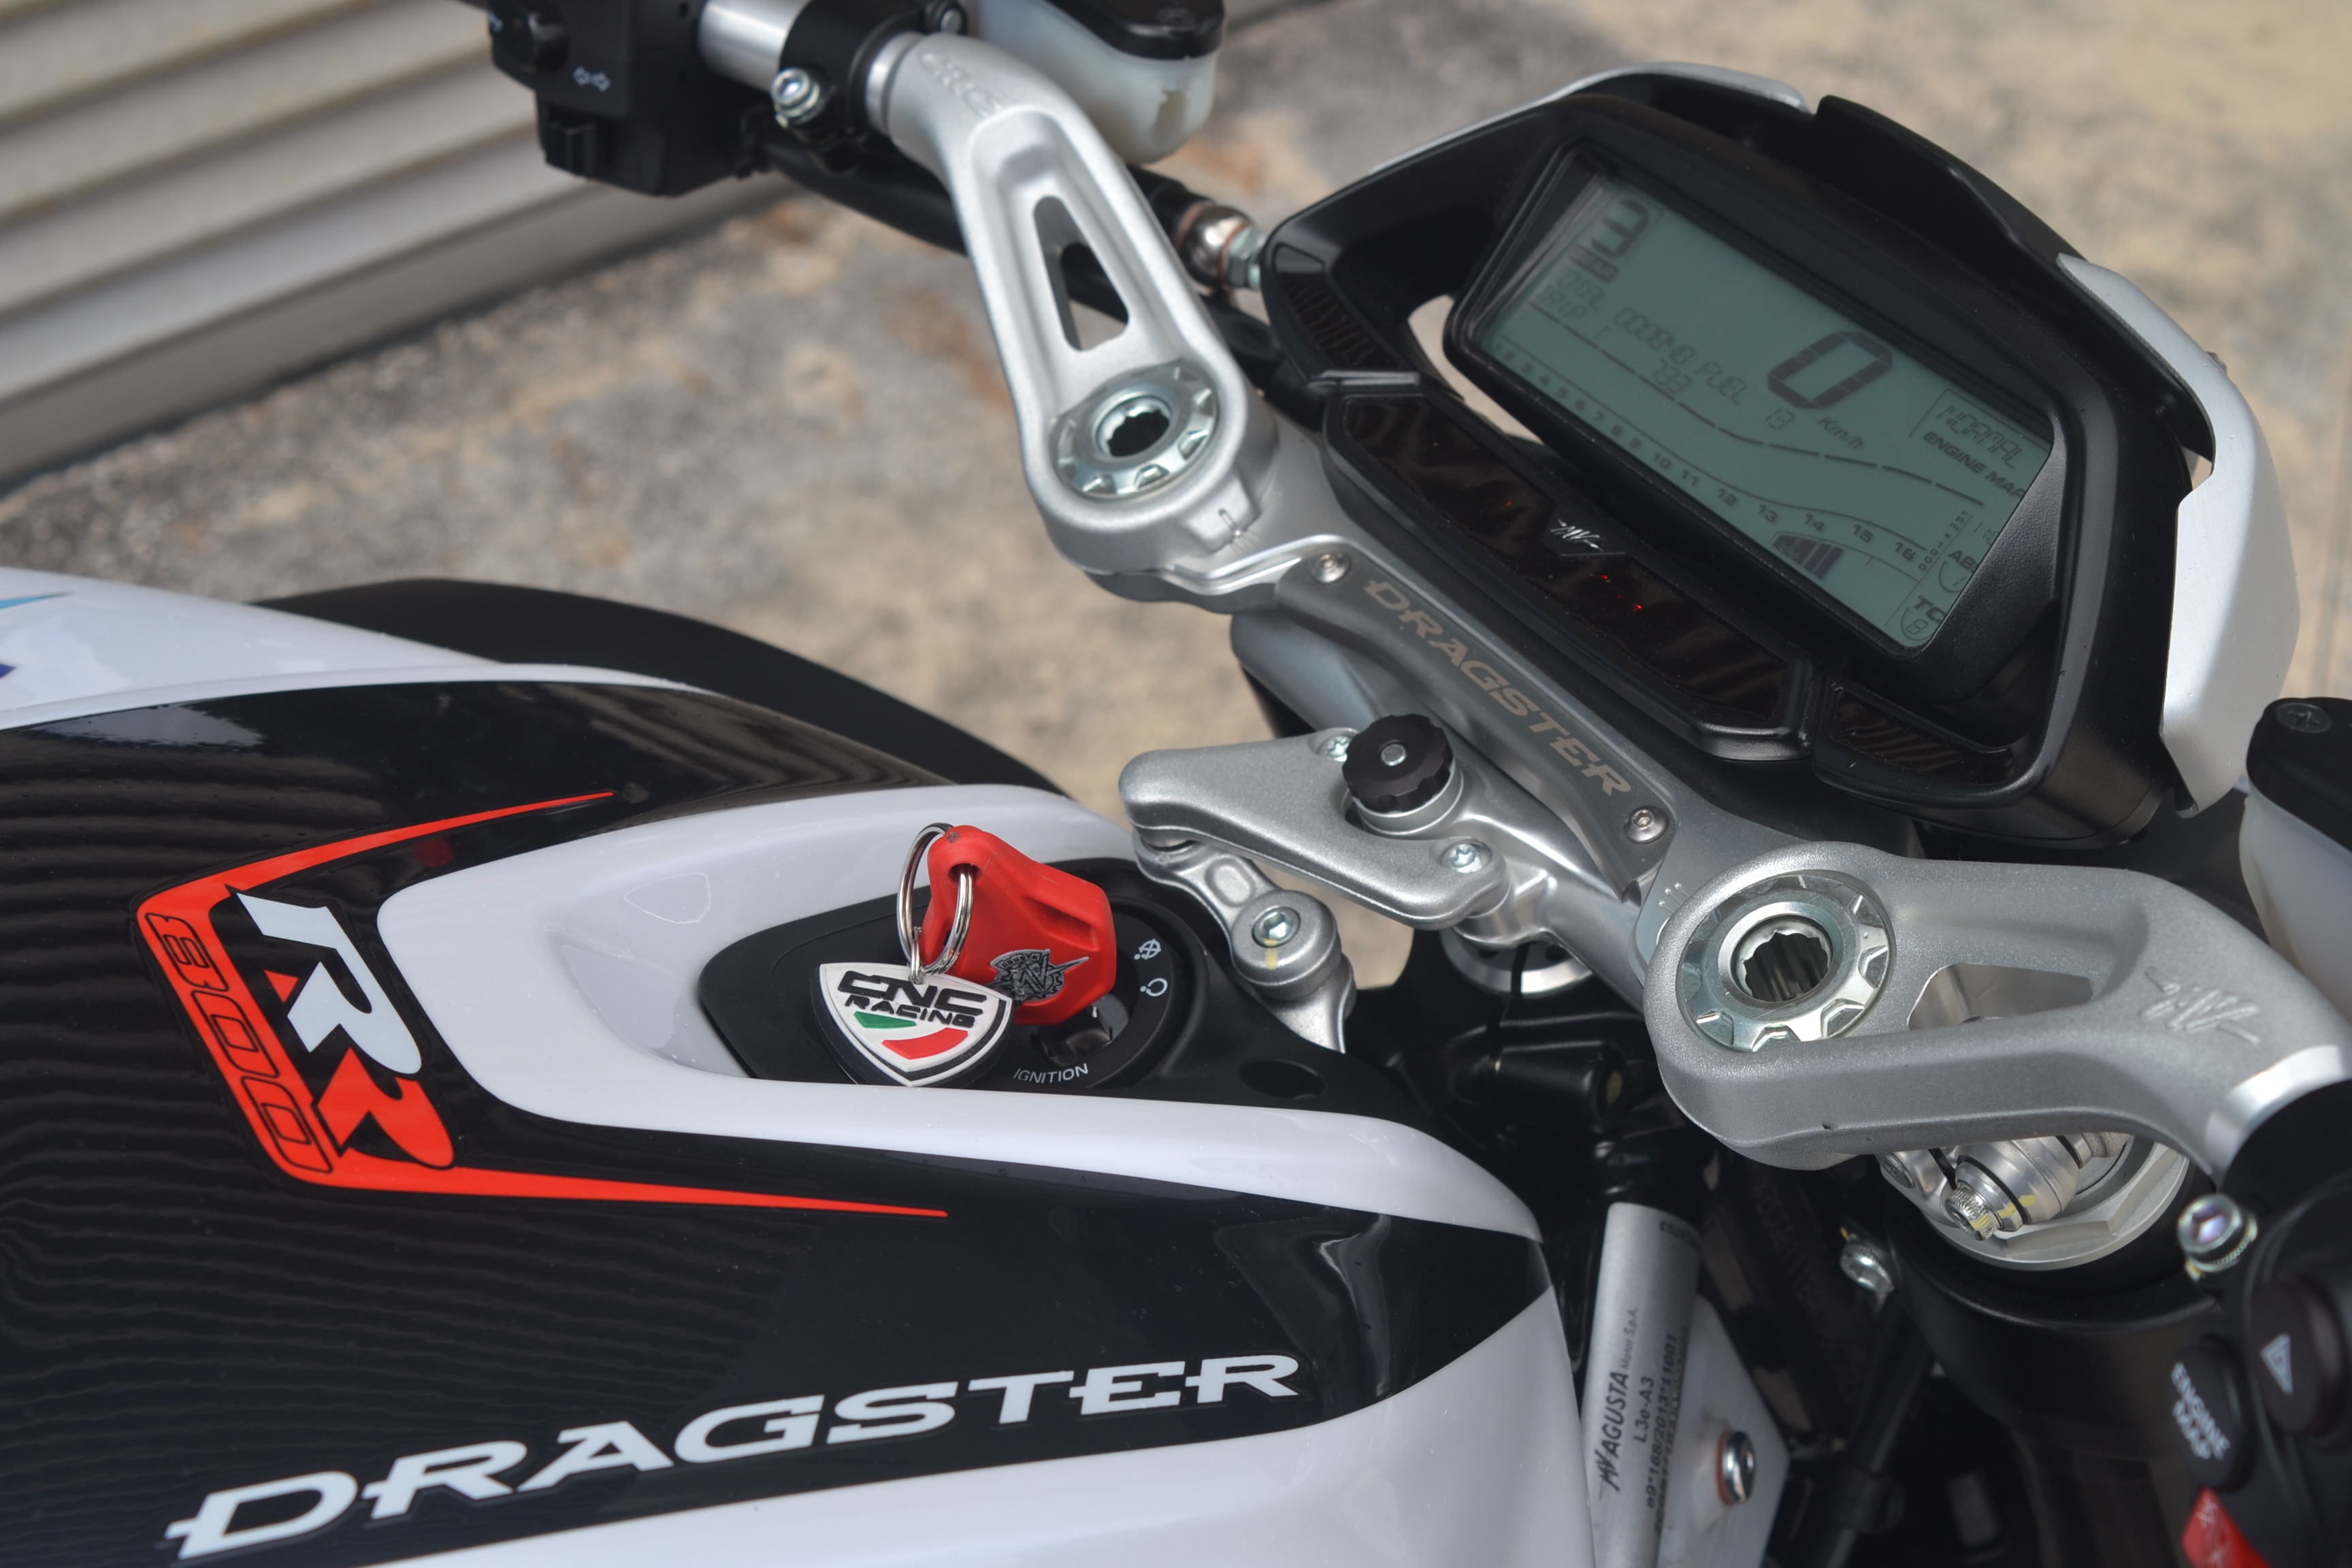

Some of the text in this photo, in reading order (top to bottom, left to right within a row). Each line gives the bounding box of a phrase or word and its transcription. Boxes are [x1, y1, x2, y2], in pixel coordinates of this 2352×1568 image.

[1590, 199, 1650, 258] 3
[1652, 358, 1692, 393] 733
[1695, 361, 1748, 405] FUEL
[1767, 331, 1895, 410] 0
[1923, 431, 1987, 474] ENGINE
[1936, 406, 2022, 470] NORMAL
[1653, 452, 1671, 470] 10
[1682, 469, 1699, 487] 11
[1718, 489, 1737, 507] 12
[1758, 504, 1778, 523] 13
[1806, 514, 1825, 532] 14
[1852, 524, 1874, 543] 15
[1895, 542, 1916, 561] 16
[1906, 618, 1929, 636] 8
[1914, 595, 1946, 624] TC
[1363, 579, 1632, 797] DRAGSTER
[1001, 954, 1039, 970] AGUSTA
[837, 970, 987, 1017] CNC
[844, 994, 977, 1029] RACING
[144, 913, 334, 1174] 800
[1013, 1063, 1090, 1085] IGNITION
[1601, 1371, 1630, 1458] AGUSTA
[1619, 1339, 1635, 1371] Motor
[1633, 1376, 1654, 1444] L3e-A3
[2170, 1362, 2230, 1460] ENGINE
[163, 1354, 1299, 1561] DRAGSTER
